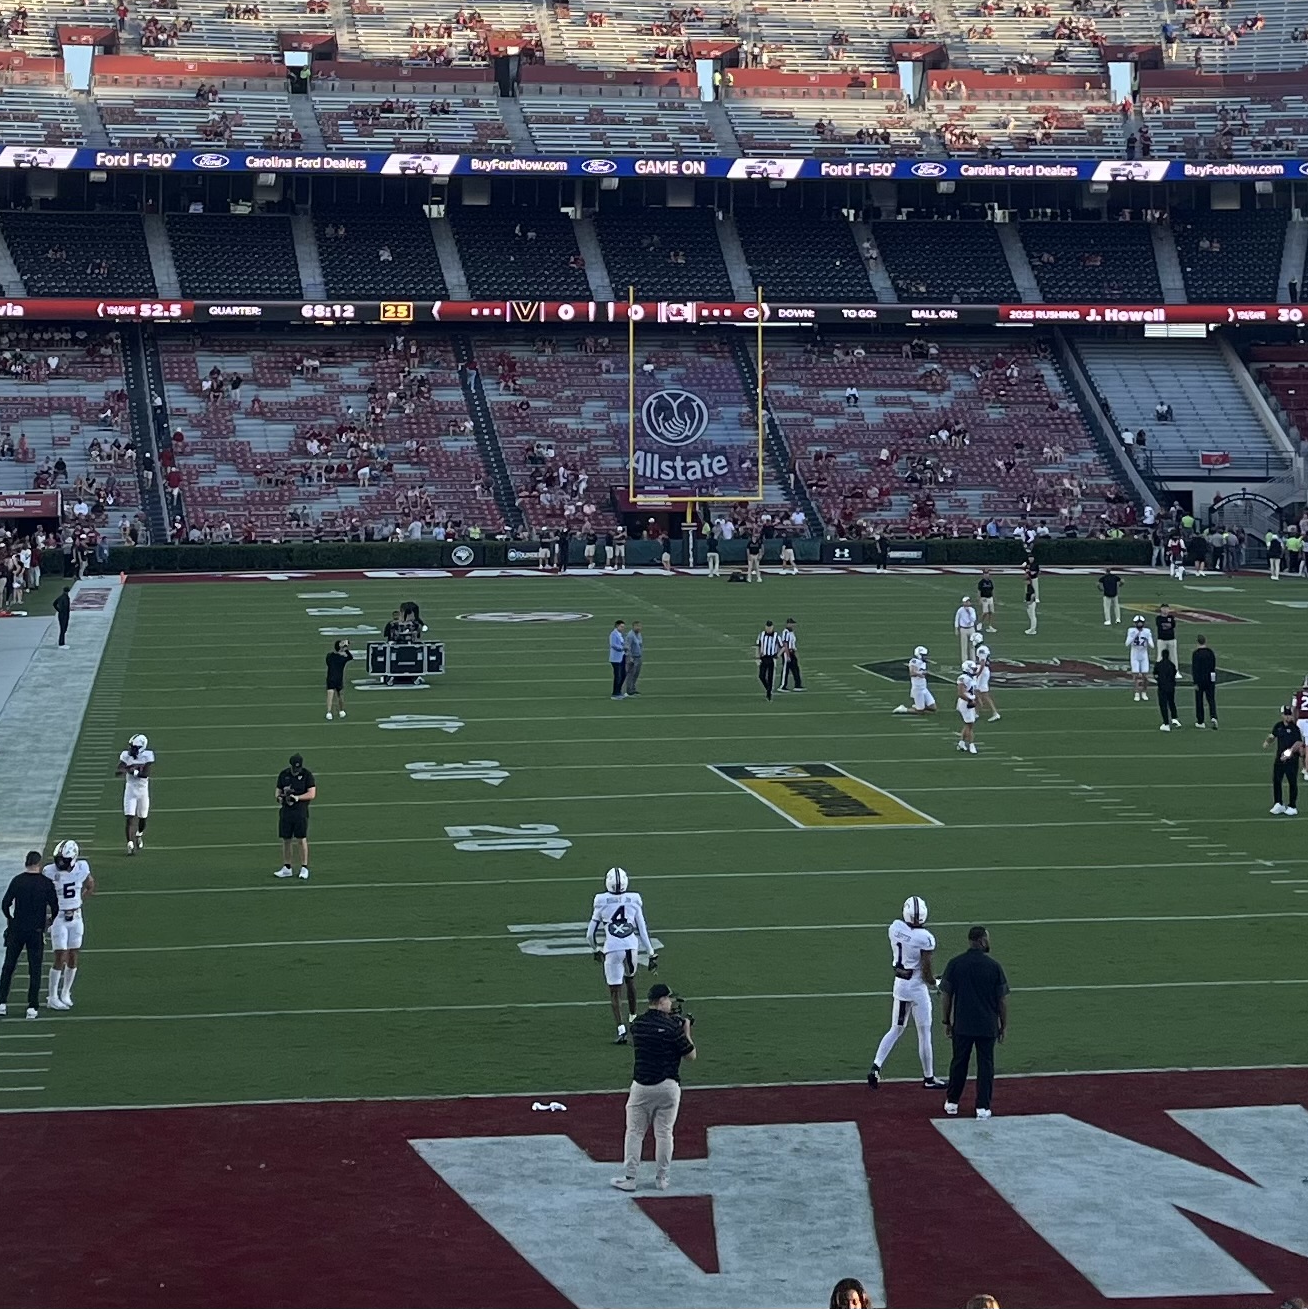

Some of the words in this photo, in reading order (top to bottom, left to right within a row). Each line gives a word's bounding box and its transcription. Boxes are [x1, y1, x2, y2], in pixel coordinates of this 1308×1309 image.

[96, 152, 129, 167] Ford
[246, 156, 292, 169] Carolina
[295, 156, 321, 169] Ford
[324, 157, 366, 170] Dealers
[470, 157, 567, 172] BuyFordNow.com
[634, 160, 678, 174] GAME
[681, 160, 705, 174] ON
[821, 163, 851, 176] Ford
[960, 164, 1006, 177] Carolina
[1008, 164, 1033, 177] Ford
[1035, 164, 1078, 177] Dealers
[1184, 164, 1284, 177] BuyFordNow.com
[140, 304, 182, 317] 52.5
[208, 306, 262, 316] QUARTER:
[301, 304, 355, 318] 68:12
[384, 305, 408, 318] 25
[778, 308, 815, 318] DOWN:
[842, 308, 857, 318] TO
[858, 308, 877, 318] GO:
[911, 308, 938, 319] BALL
[940, 308, 958, 319] ON:
[1009, 310, 1034, 320] 2025
[1035, 310, 1080, 320] RUSHING
[1086, 308, 1102, 321] J.
[1104, 308, 1166, 322] Howell
[1278, 308, 1303, 322] 30
[626, 449, 729, 481] Allstate
[6, 497, 41, 507] Williams
[611, 905, 628, 924] 4
[896, 942, 903, 969] 1
